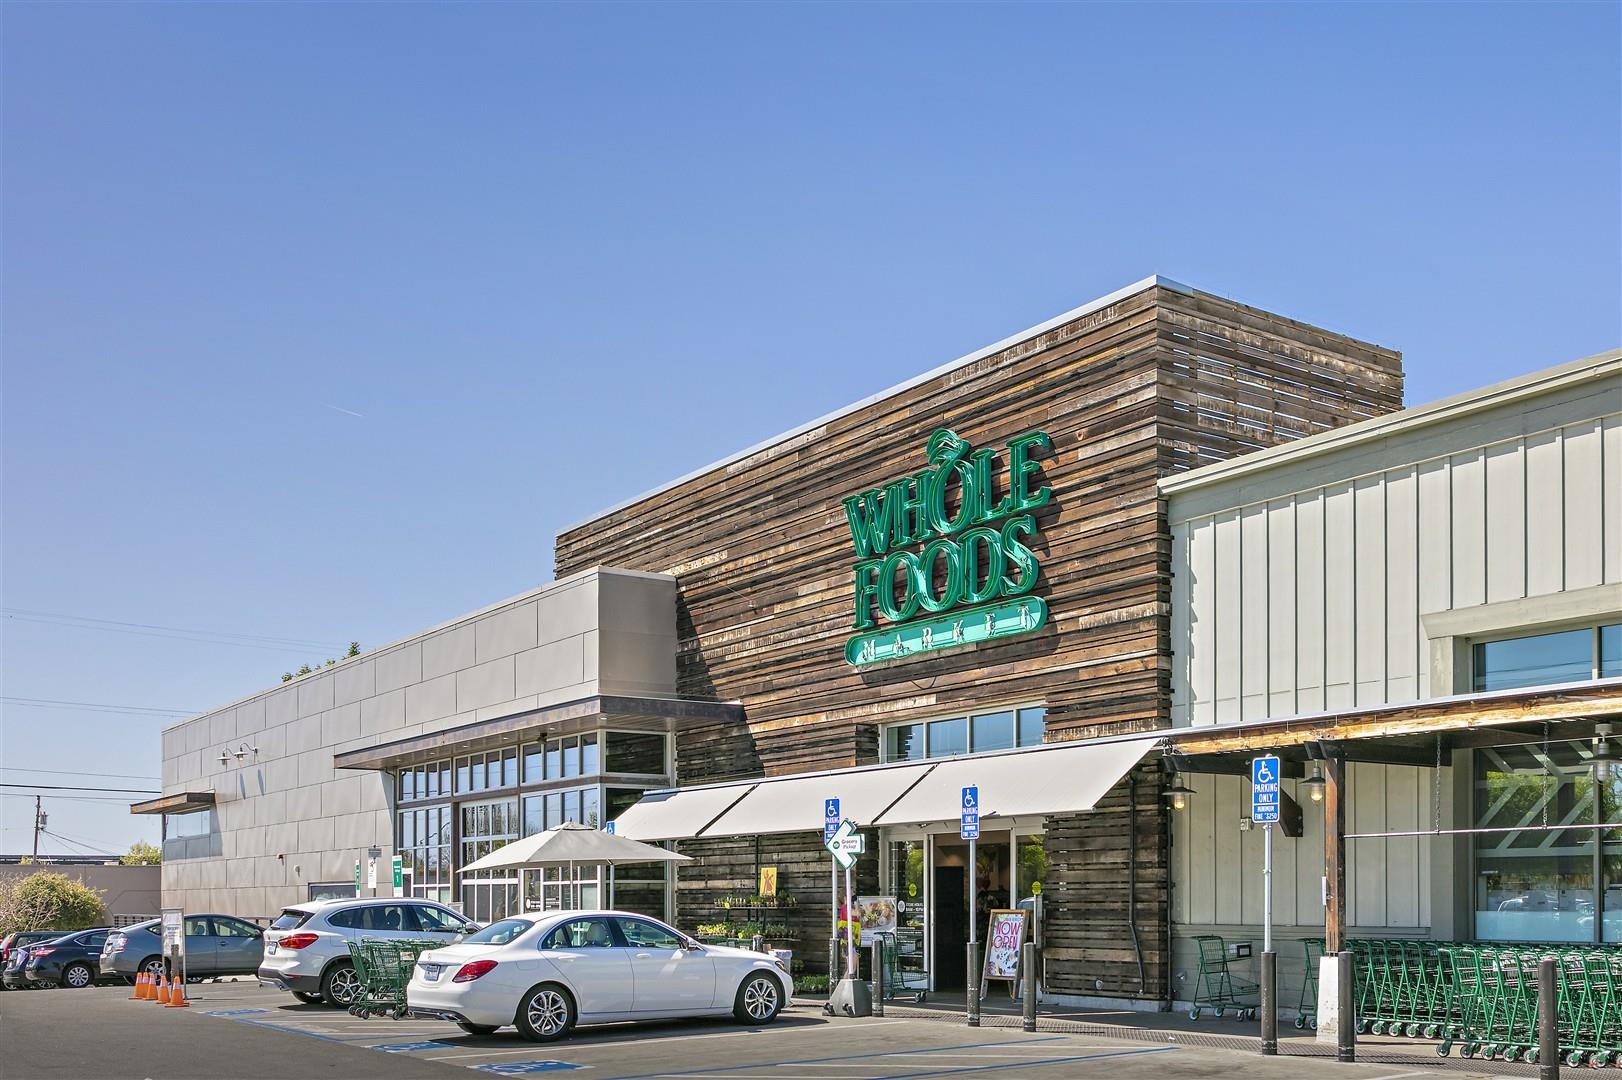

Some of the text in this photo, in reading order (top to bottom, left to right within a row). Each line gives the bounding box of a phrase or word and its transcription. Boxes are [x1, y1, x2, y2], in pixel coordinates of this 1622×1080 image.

[841, 430, 1052, 559] WHOLE
[852, 514, 1040, 630] FOODS
[862, 604, 1038, 660] MARKET
[1254, 783, 1278, 792] PARKING
[1258, 794, 1274, 802] ONLY
[995, 922, 1020, 935] NOW
[994, 936, 1018, 950] OPEN
